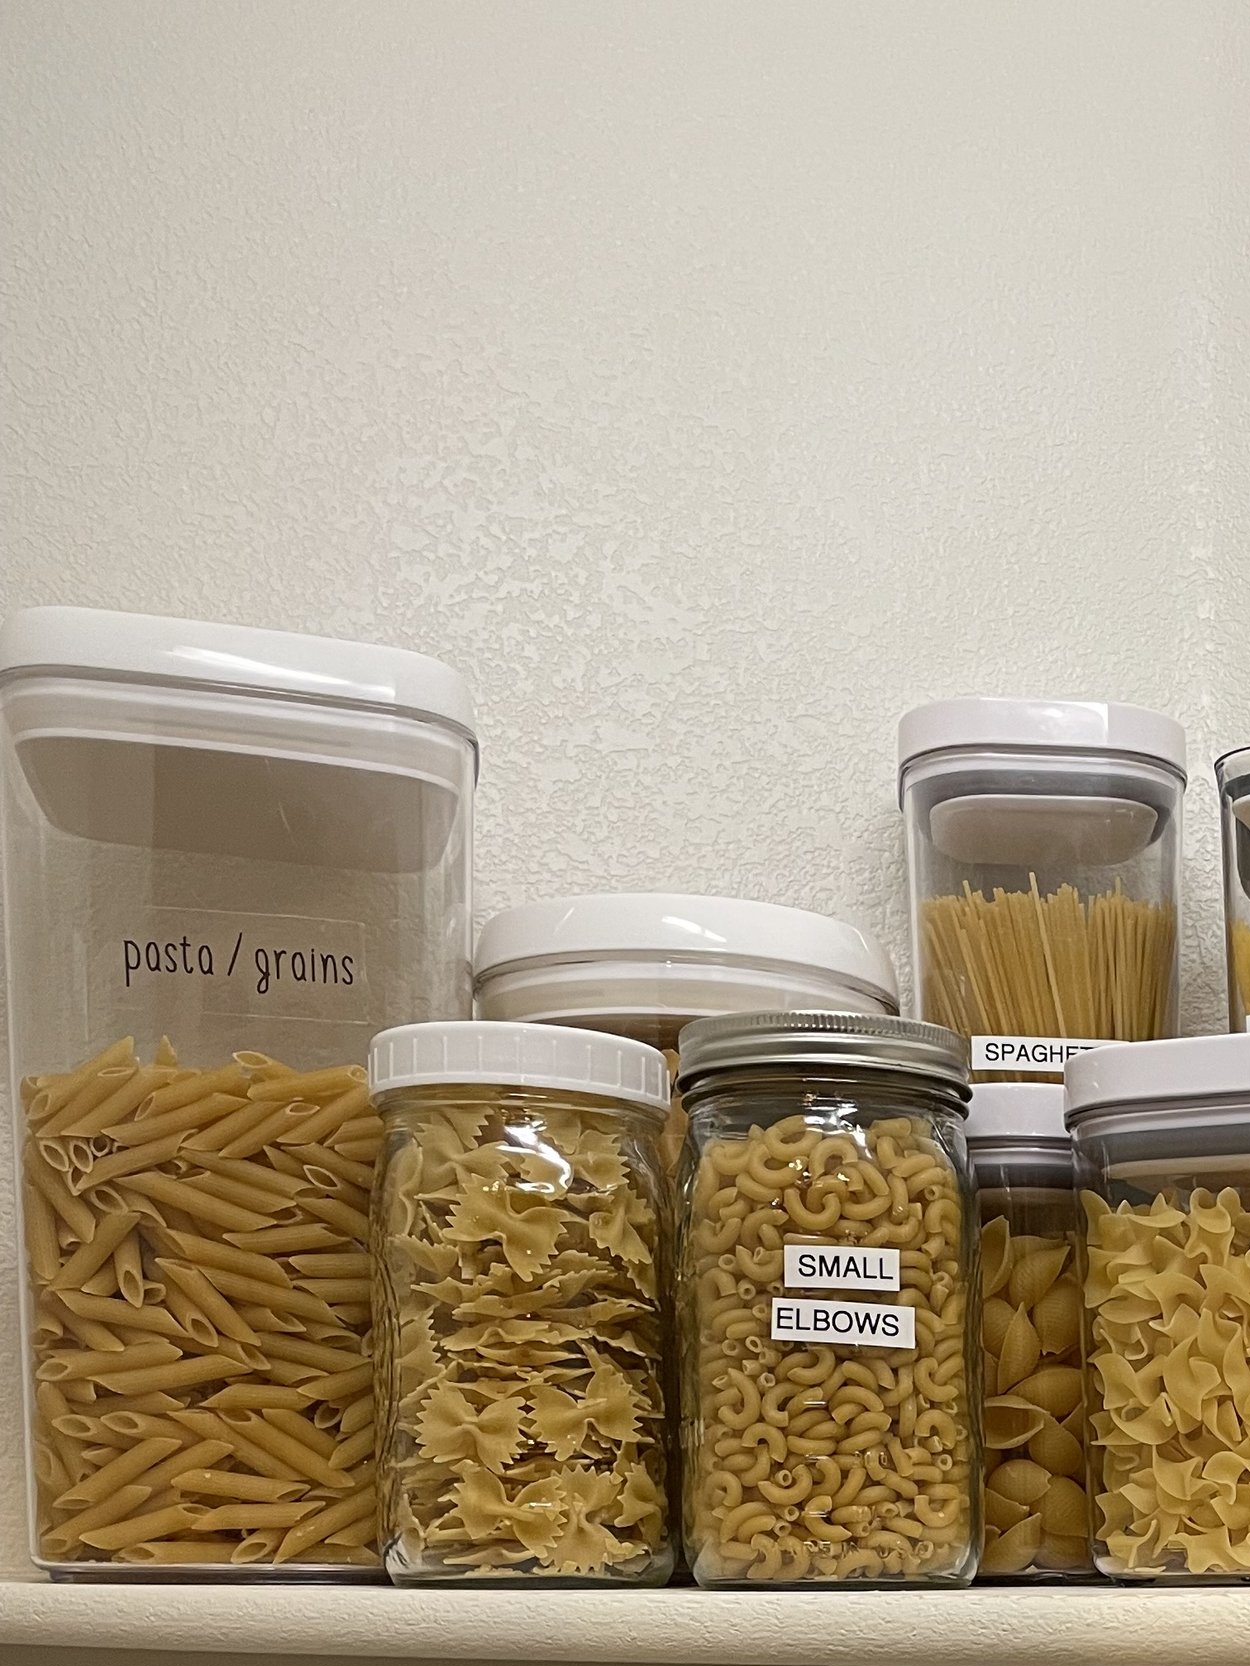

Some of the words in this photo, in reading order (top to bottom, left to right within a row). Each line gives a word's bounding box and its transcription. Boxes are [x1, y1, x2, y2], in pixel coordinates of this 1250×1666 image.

[123, 936, 214, 987] pasta
[227, 932, 243, 976] /
[255, 948, 354, 994] grains
[985, 1042, 1098, 1063] SPAGHE
[798, 1254, 894, 1280] SMALL
[776, 1307, 900, 1337] ELBOWS
